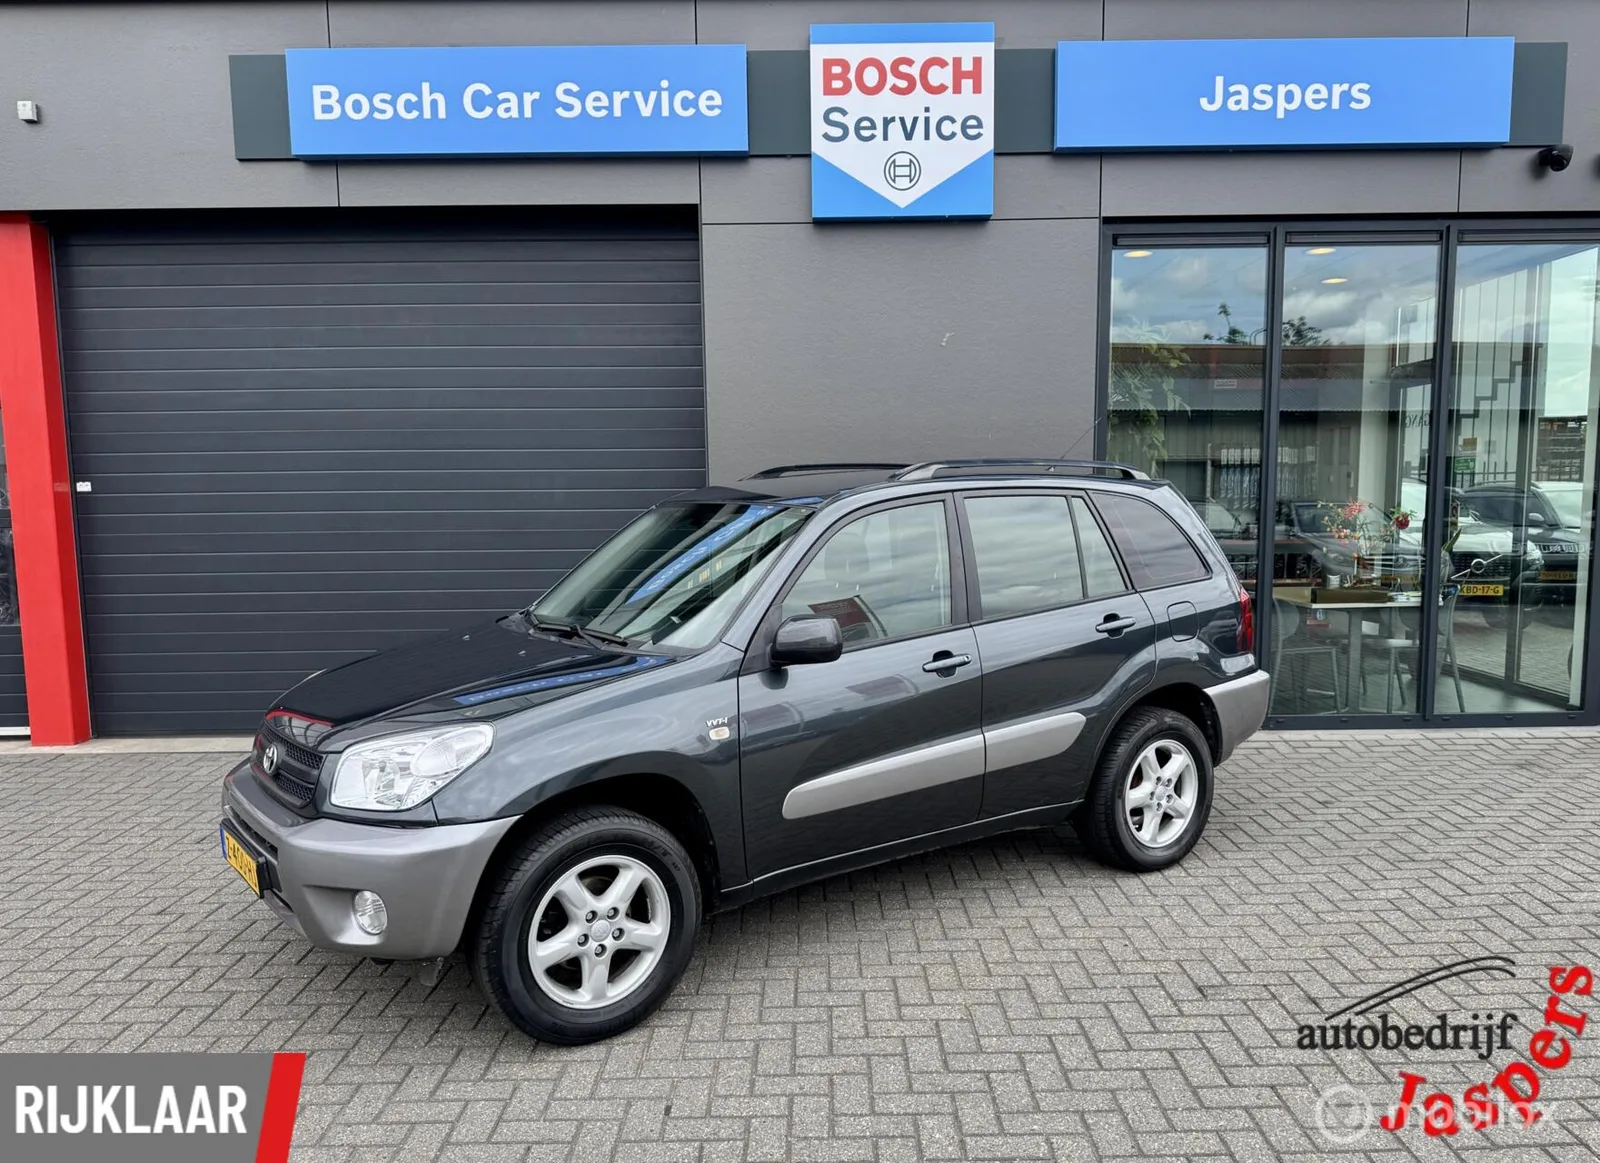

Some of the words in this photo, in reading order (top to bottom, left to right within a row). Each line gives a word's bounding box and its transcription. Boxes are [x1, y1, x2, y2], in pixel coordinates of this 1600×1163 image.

[823, 57, 982, 95] BOSCH
[311, 83, 447, 120] Bosch
[463, 83, 540, 119] Car
[555, 79, 723, 118] Service
[1199, 75, 1372, 119] Jaspers
[821, 106, 985, 143] Service
